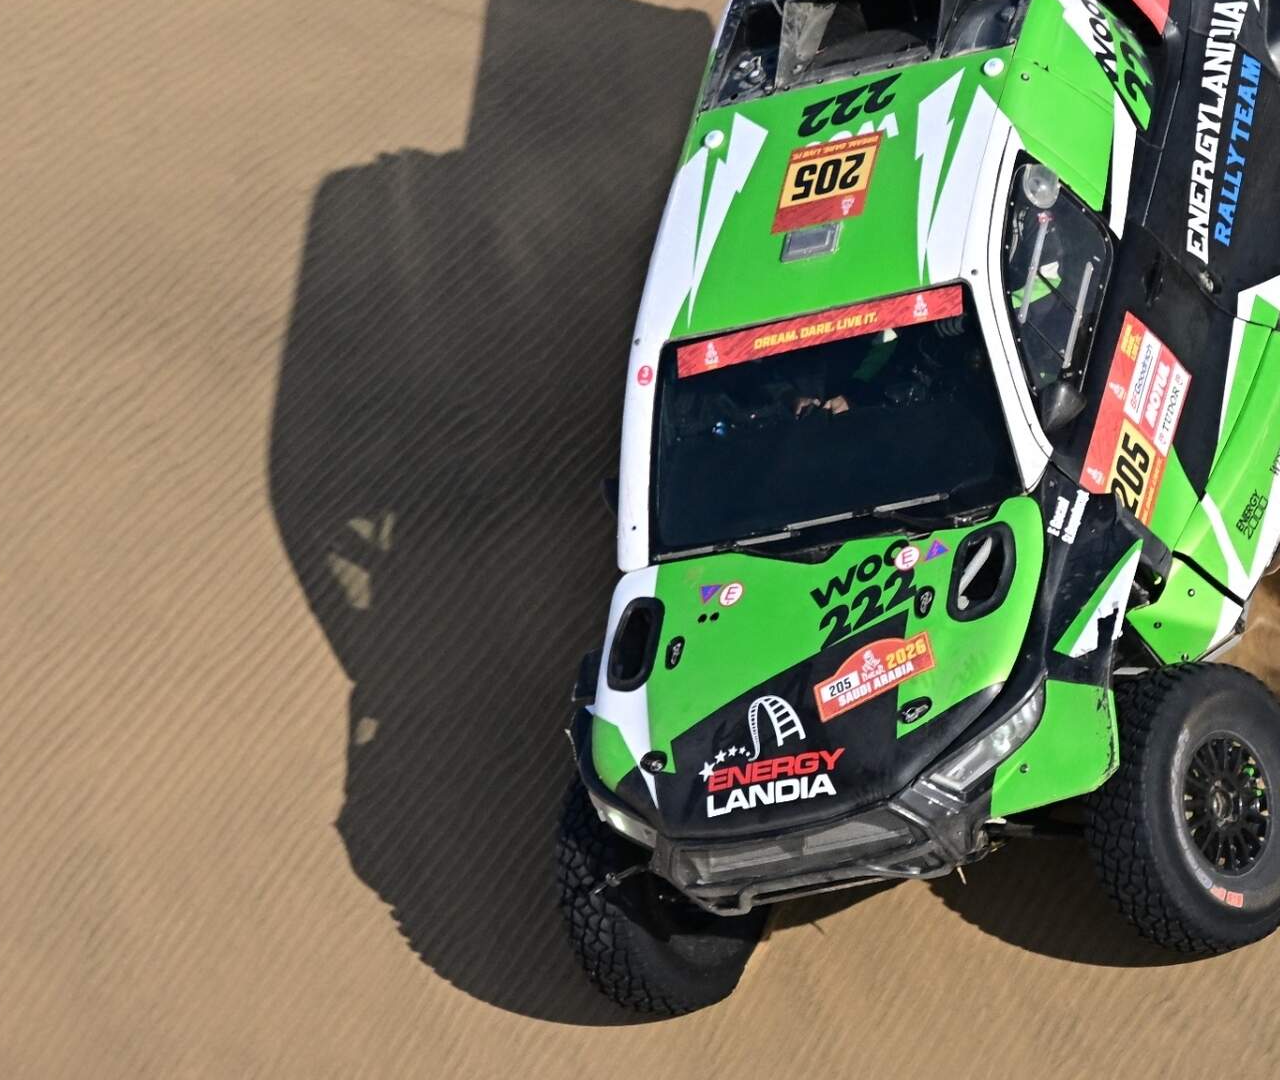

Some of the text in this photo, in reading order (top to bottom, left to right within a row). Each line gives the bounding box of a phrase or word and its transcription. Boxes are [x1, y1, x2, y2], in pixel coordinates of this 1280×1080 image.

[798, 72, 902, 137] 222
[1186, 1, 1248, 265] ENERGYLANDIA
[1214, 53, 1263, 247] RALLY TEAM
[791, 153, 866, 201] 205
[753, 311, 878, 350] DREAM. DARE. LIVE IT.
[1129, 343, 1153, 410] BFGoodrich
[1161, 386, 1179, 433] TUDOR
[1111, 432, 1150, 517] 205
[1236, 489, 1260, 533] ENERGY
[819, 568, 917, 650] 222
[885, 638, 927, 670] 2026
[829, 677, 852, 697] 205
[838, 661, 914, 707] SAUDI ARABIA
[708, 747, 845, 793] ENERGY
[707, 773, 837, 818] LANDIA
